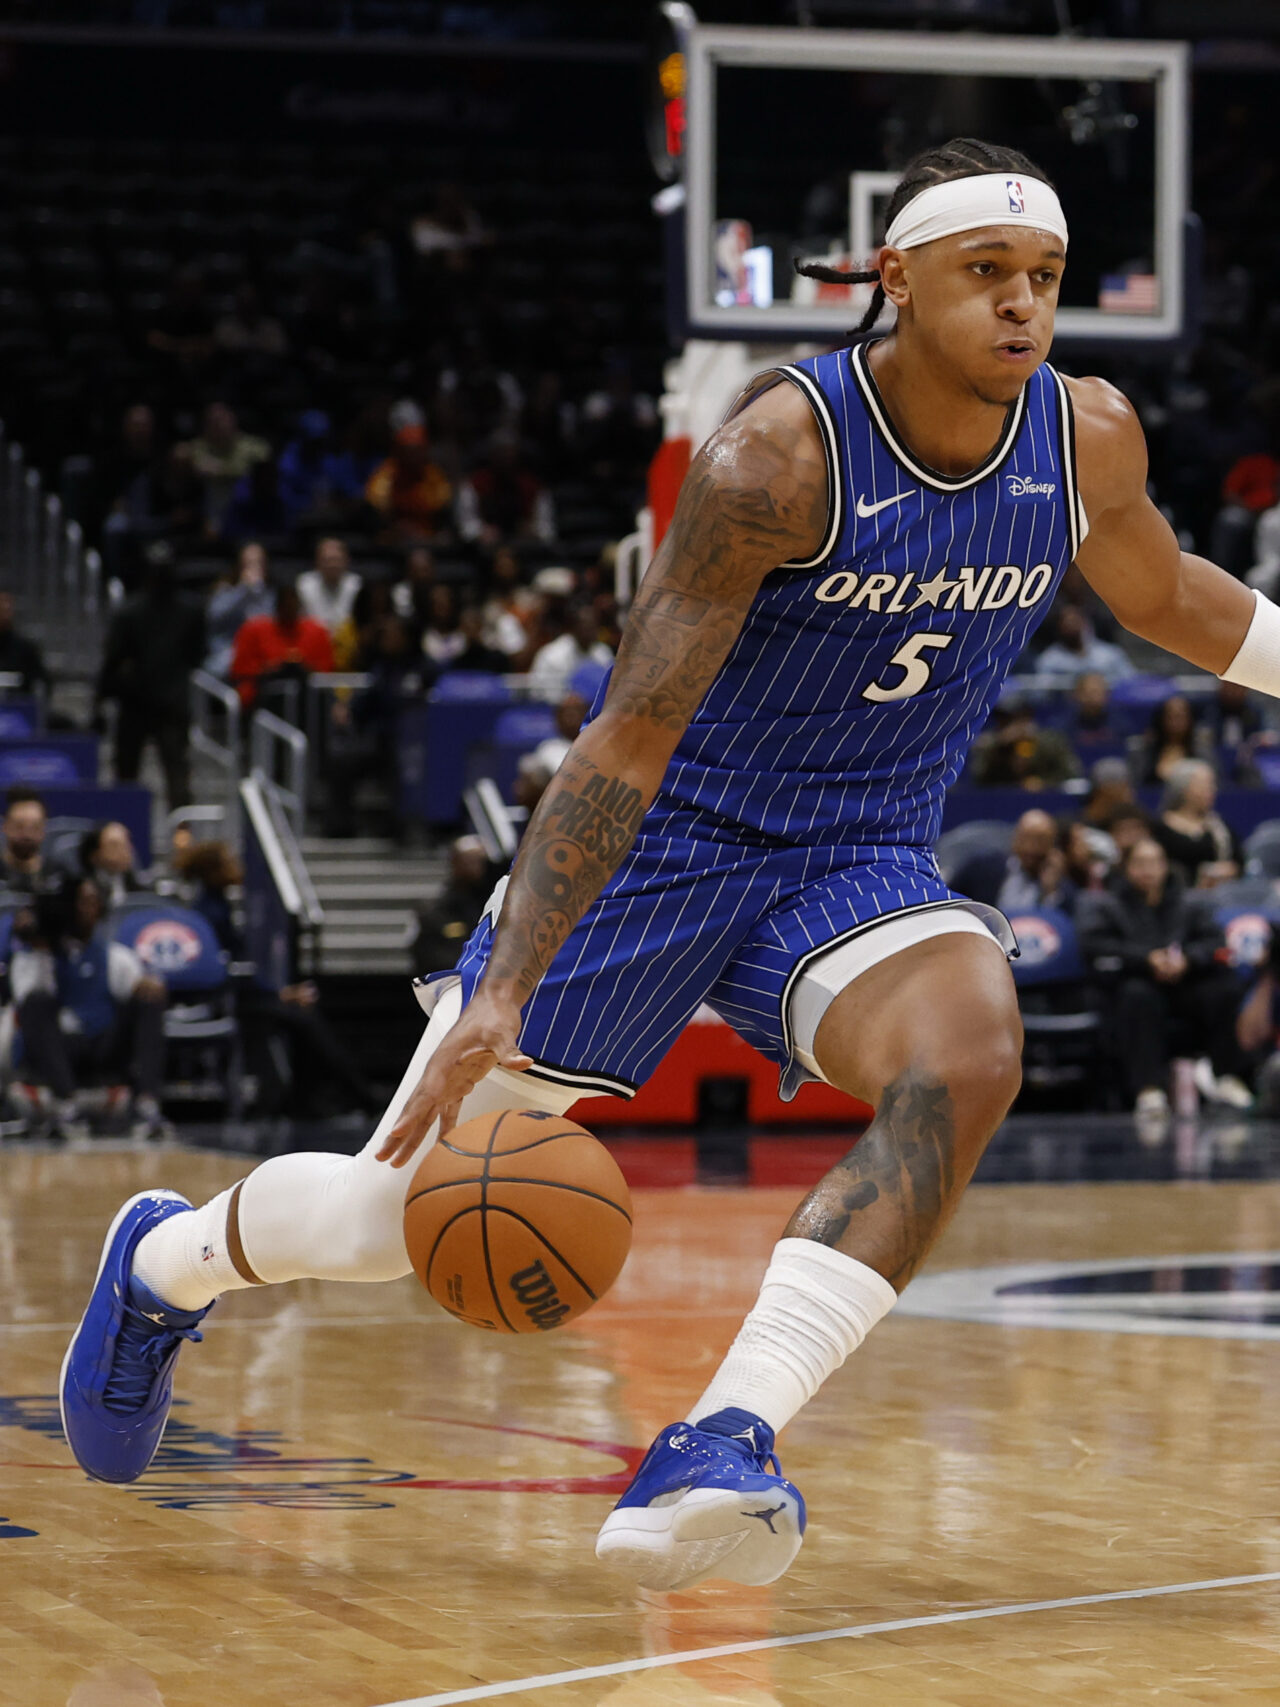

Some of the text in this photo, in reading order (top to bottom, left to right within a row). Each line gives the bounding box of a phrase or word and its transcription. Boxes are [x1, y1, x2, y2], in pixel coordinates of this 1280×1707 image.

[1005, 474, 1056, 500] Disney
[814, 563, 1053, 614] ORLANDO
[861, 632, 953, 703] 5
